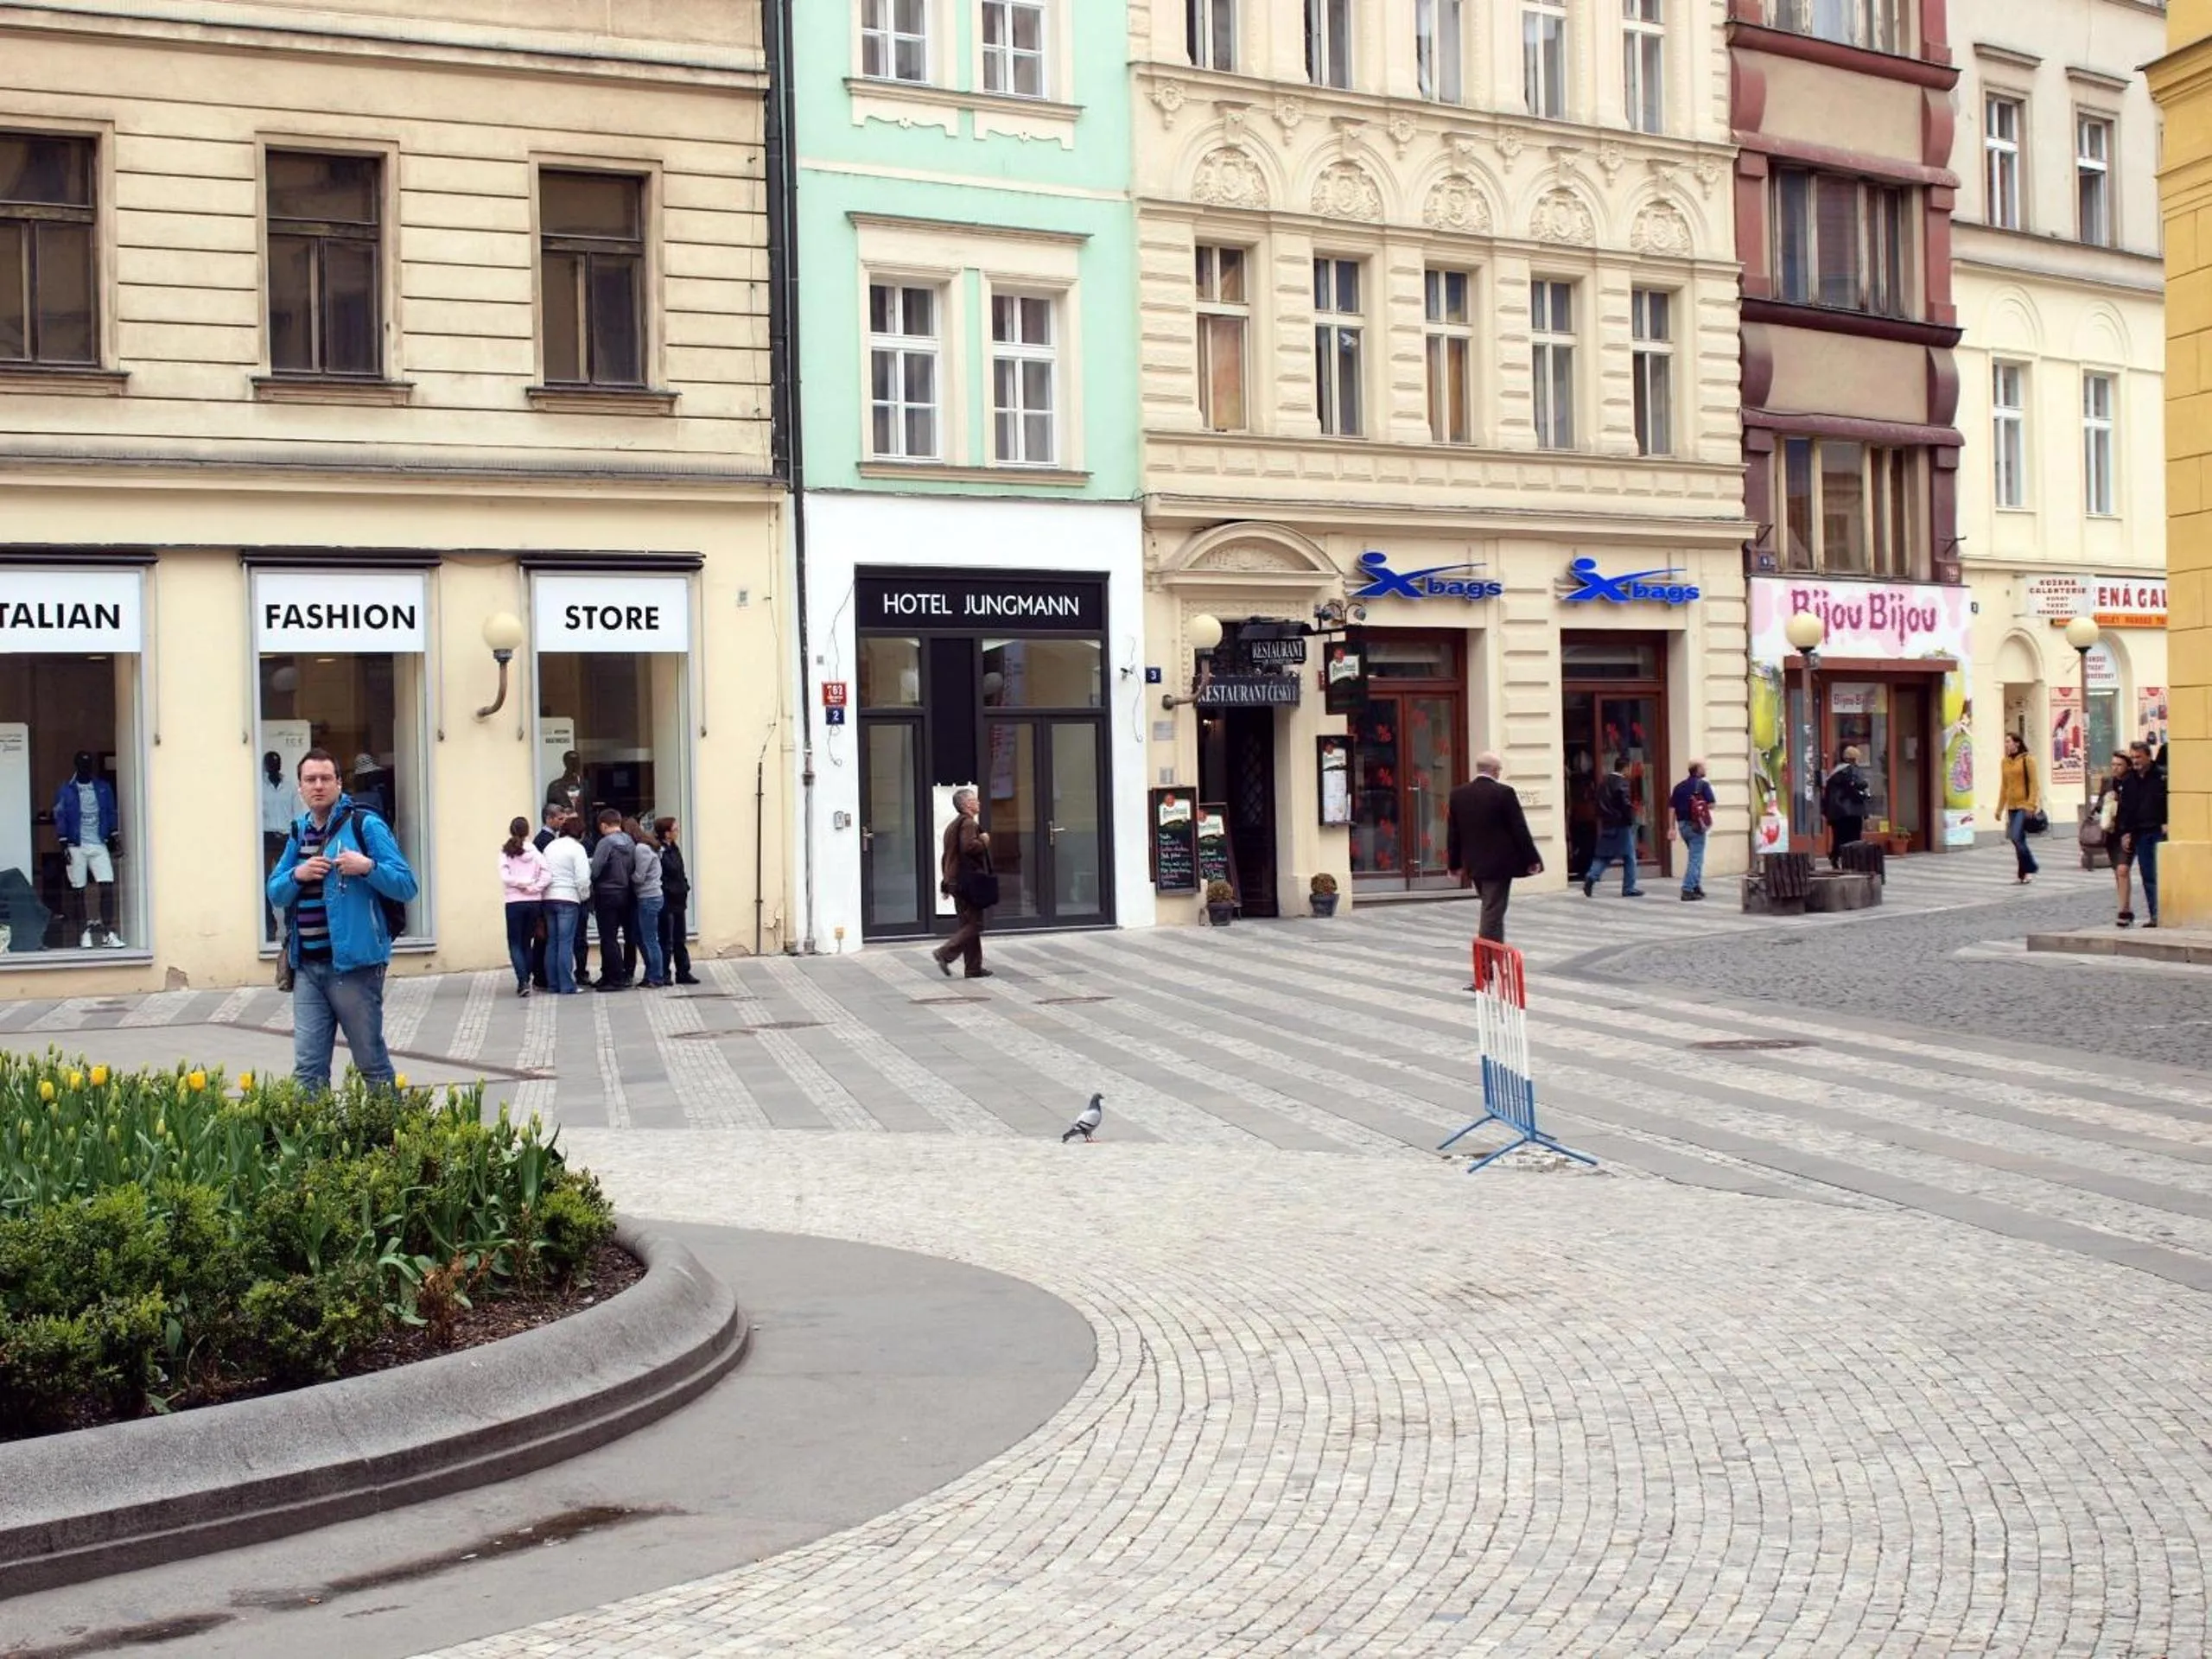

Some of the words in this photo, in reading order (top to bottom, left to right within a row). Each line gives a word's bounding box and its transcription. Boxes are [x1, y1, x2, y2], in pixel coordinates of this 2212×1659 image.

[883, 593, 953, 614] HOTEL
[964, 594, 1079, 616] JUNGMANN
[2094, 584, 2133, 607] ENÁ
[265, 604, 416, 630] FASHION
[565, 604, 659, 630] STORE
[1869, 593, 1936, 646] Bijou
[1251, 639, 1304, 658] RESTAURANT
[1150, 670, 1157, 681] 3
[832, 709, 840, 721] 2
